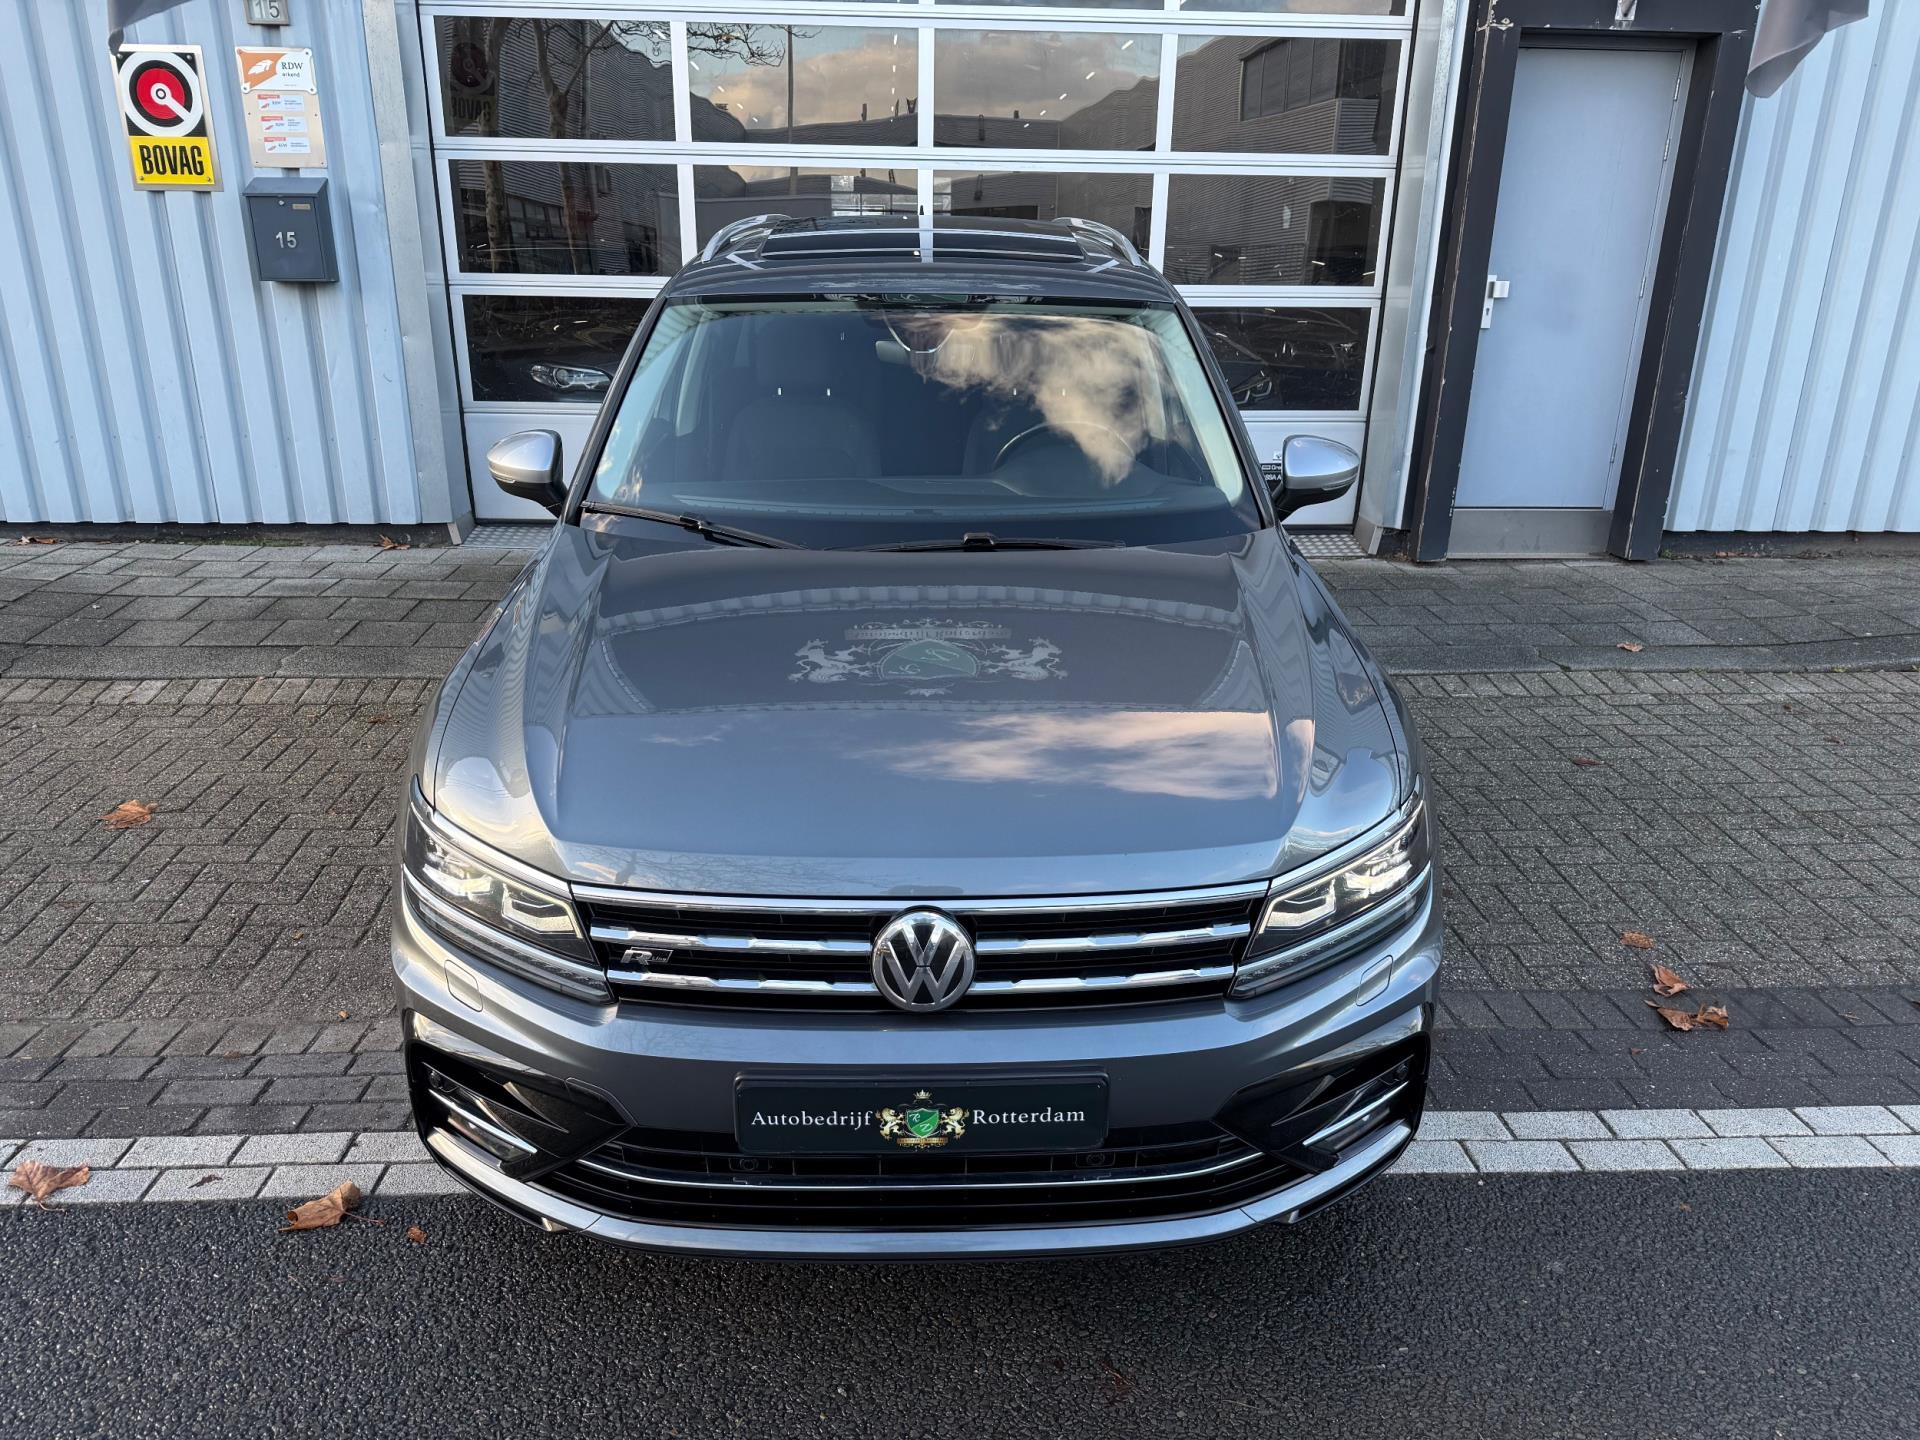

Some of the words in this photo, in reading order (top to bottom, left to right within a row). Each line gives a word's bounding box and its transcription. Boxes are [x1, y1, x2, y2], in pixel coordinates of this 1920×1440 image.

[255, 0, 280, 18] 15
[281, 62, 303, 70] RDW
[139, 145, 205, 175] BOVAG
[275, 231, 297, 248] 15
[751, 1110, 873, 1131] Autobedrijf
[972, 1106, 1086, 1125] Rotterdam
